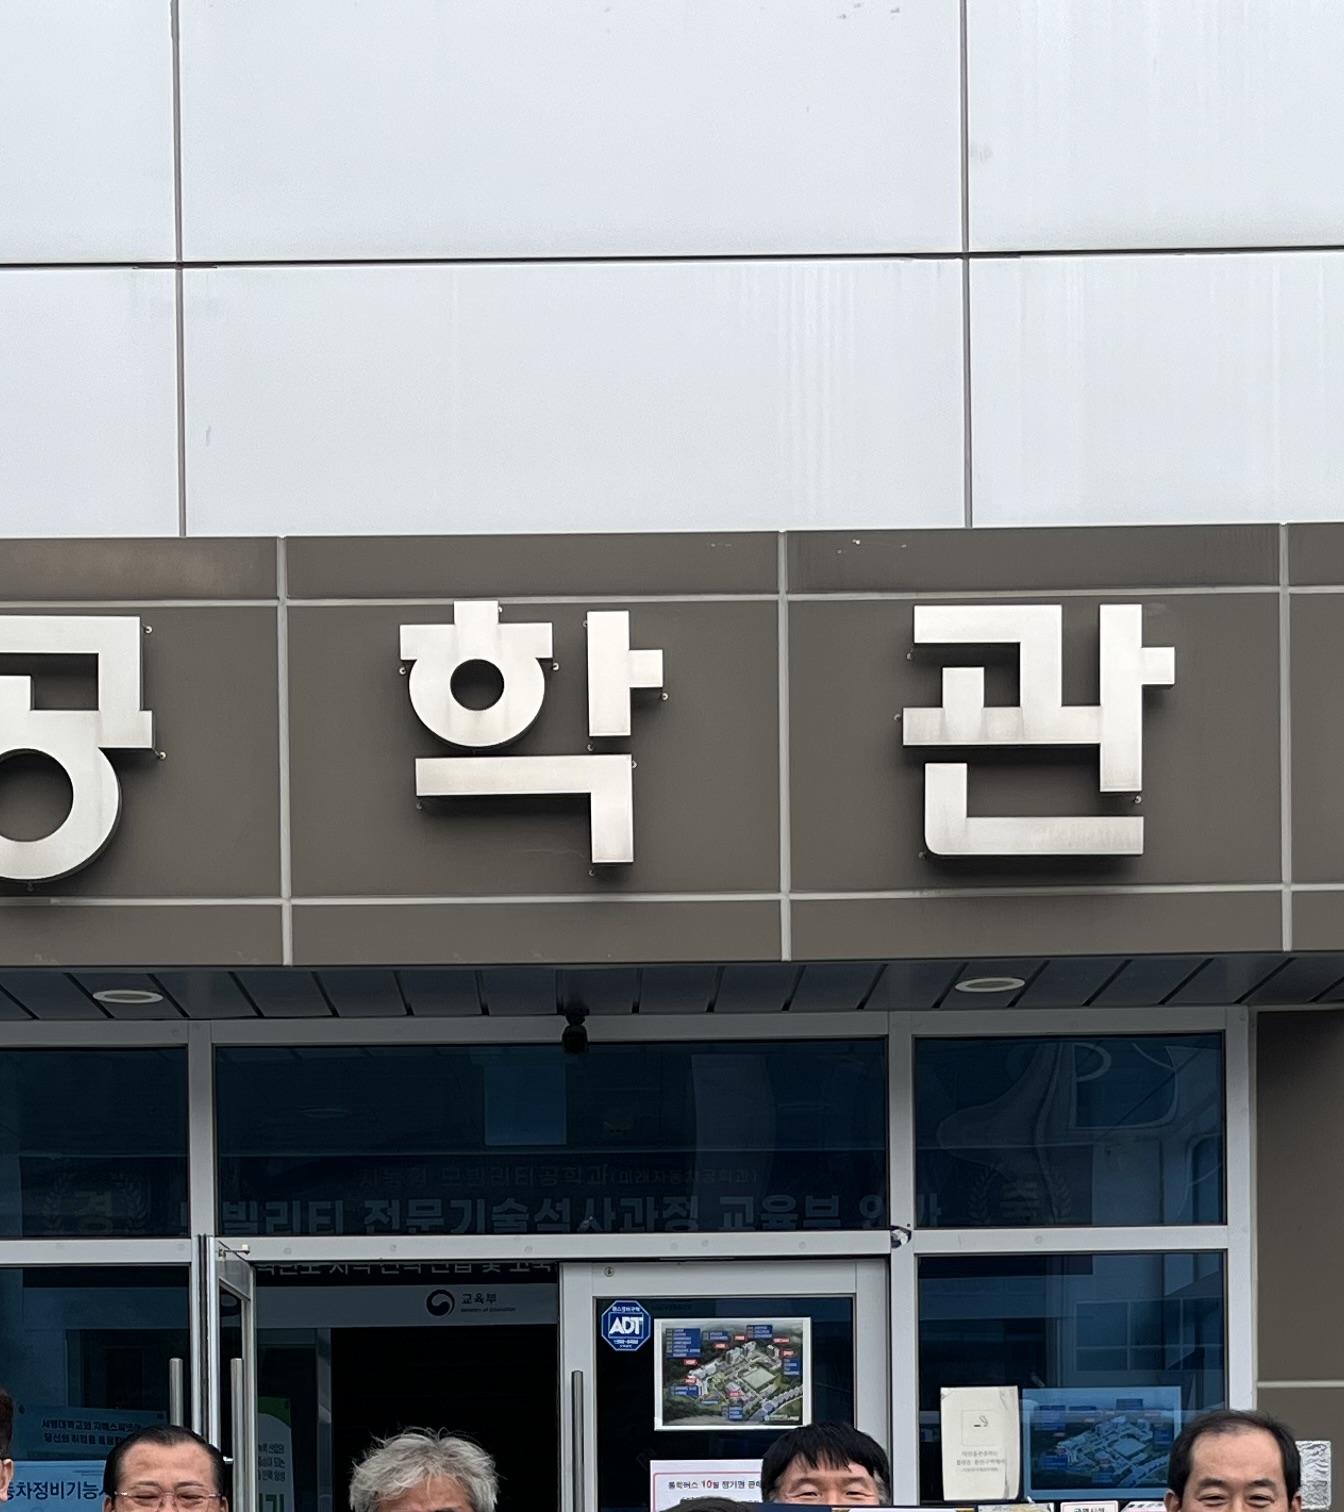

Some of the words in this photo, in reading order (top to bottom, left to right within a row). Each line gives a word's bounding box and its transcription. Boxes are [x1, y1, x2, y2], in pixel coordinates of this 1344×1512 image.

[179, 1199, 344, 1235] 빌리티
[718, 1193, 841, 1231] 교육부
[461, 1292, 497, 1305] 교육부
[608, 1316, 644, 1335] ADT
